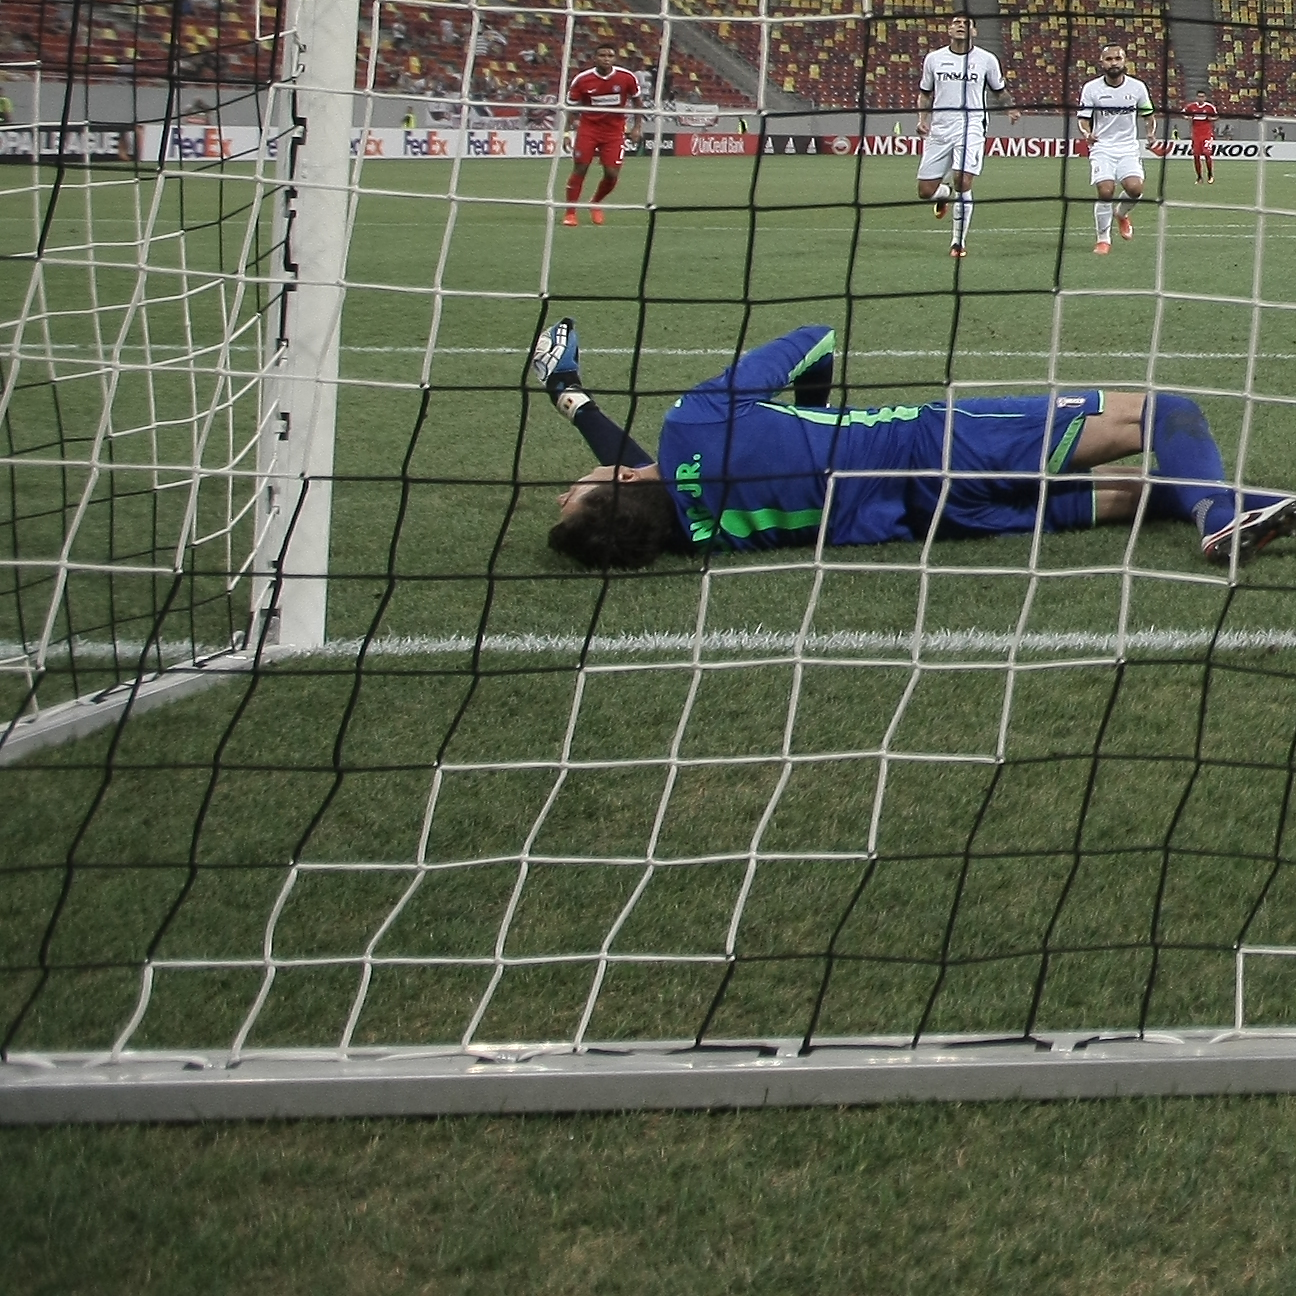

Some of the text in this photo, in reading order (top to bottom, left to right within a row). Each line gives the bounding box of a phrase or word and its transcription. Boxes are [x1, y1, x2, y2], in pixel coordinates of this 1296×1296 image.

[404, 131, 447, 155] FedEx
[467, 132, 506, 155] FedEx
[523, 133, 556, 155] FedE
[853, 136, 922, 156] AMST
[988, 137, 1079, 158] AMSTEL
[673, 452, 702, 498] JR.
